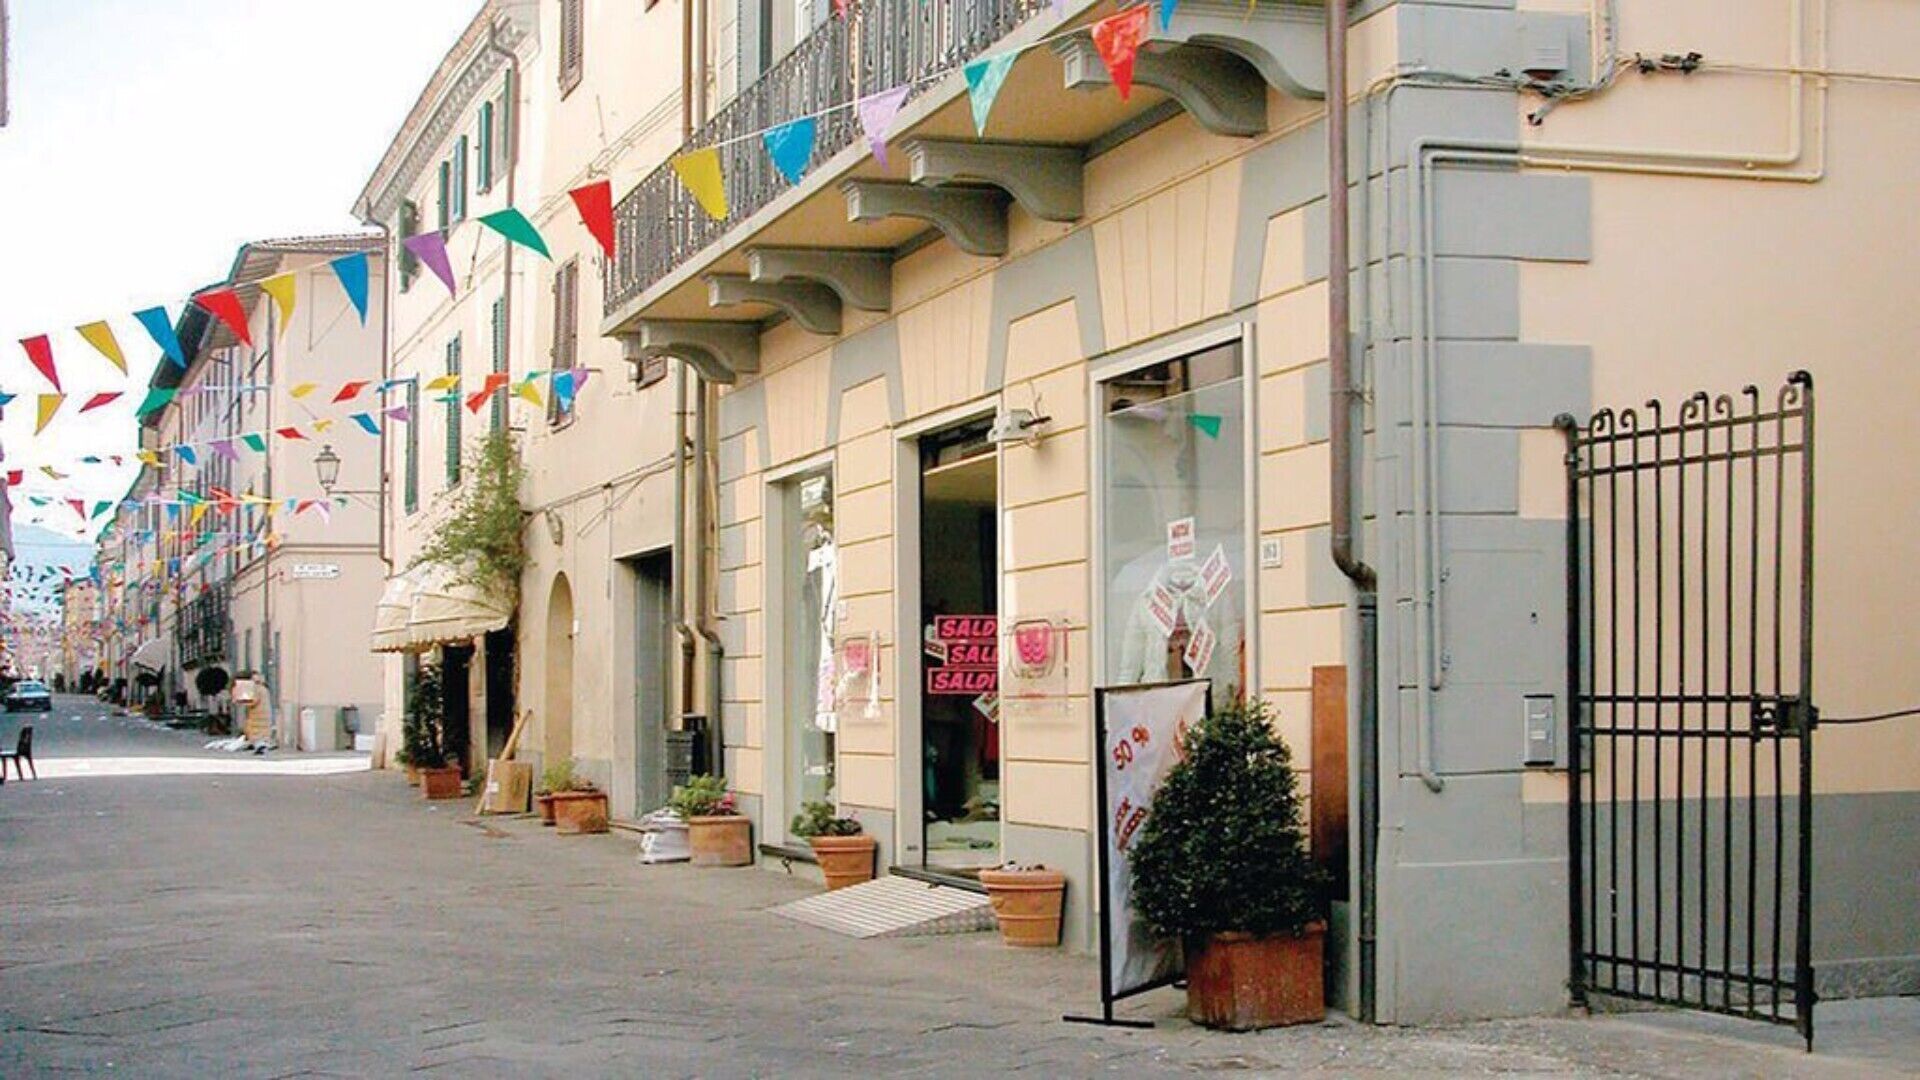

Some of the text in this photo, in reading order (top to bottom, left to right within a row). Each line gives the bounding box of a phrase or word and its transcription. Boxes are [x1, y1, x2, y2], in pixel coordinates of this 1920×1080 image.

[941, 619, 997, 637] SALD
[951, 645, 997, 663] SAL
[934, 672, 997, 690] SALDI
